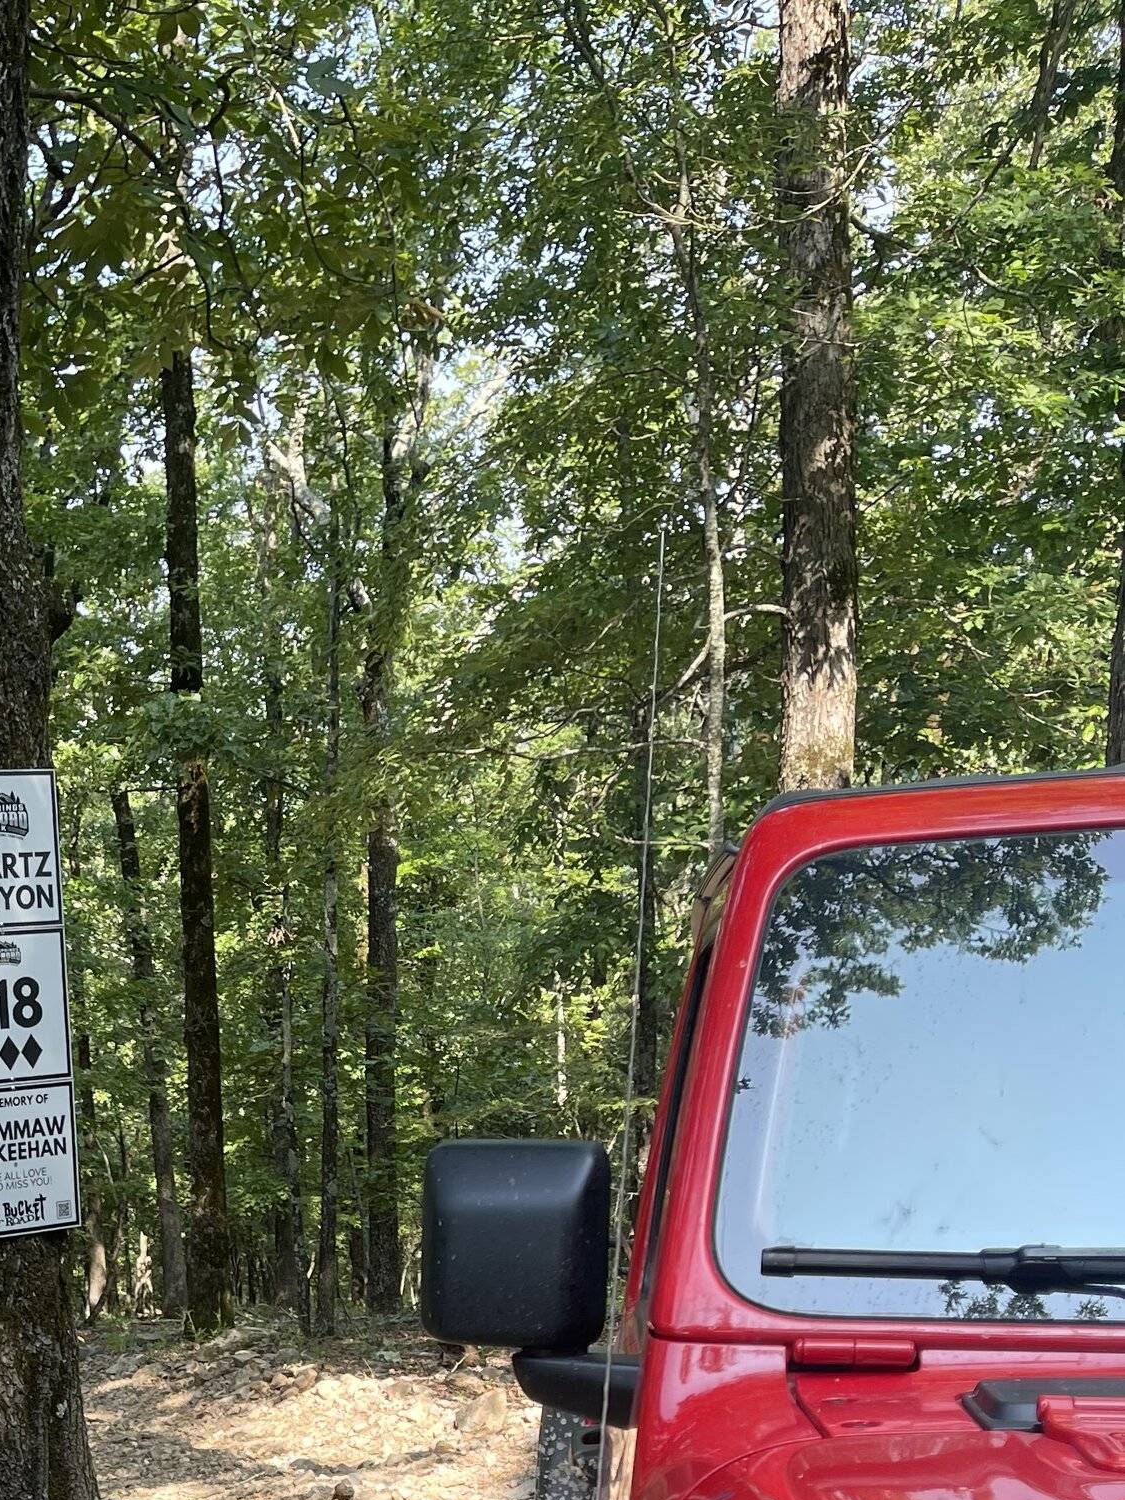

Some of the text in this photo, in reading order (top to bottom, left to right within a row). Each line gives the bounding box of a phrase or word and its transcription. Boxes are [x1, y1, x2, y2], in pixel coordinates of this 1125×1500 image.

[36, 1093, 49, 1105] OF
[4, 1169, 19, 1180] ALL
[23, 1167, 48, 1178] LOVE
[5, 1180, 29, 1190] MISS
[30, 1176, 53, 1188] YOU!
